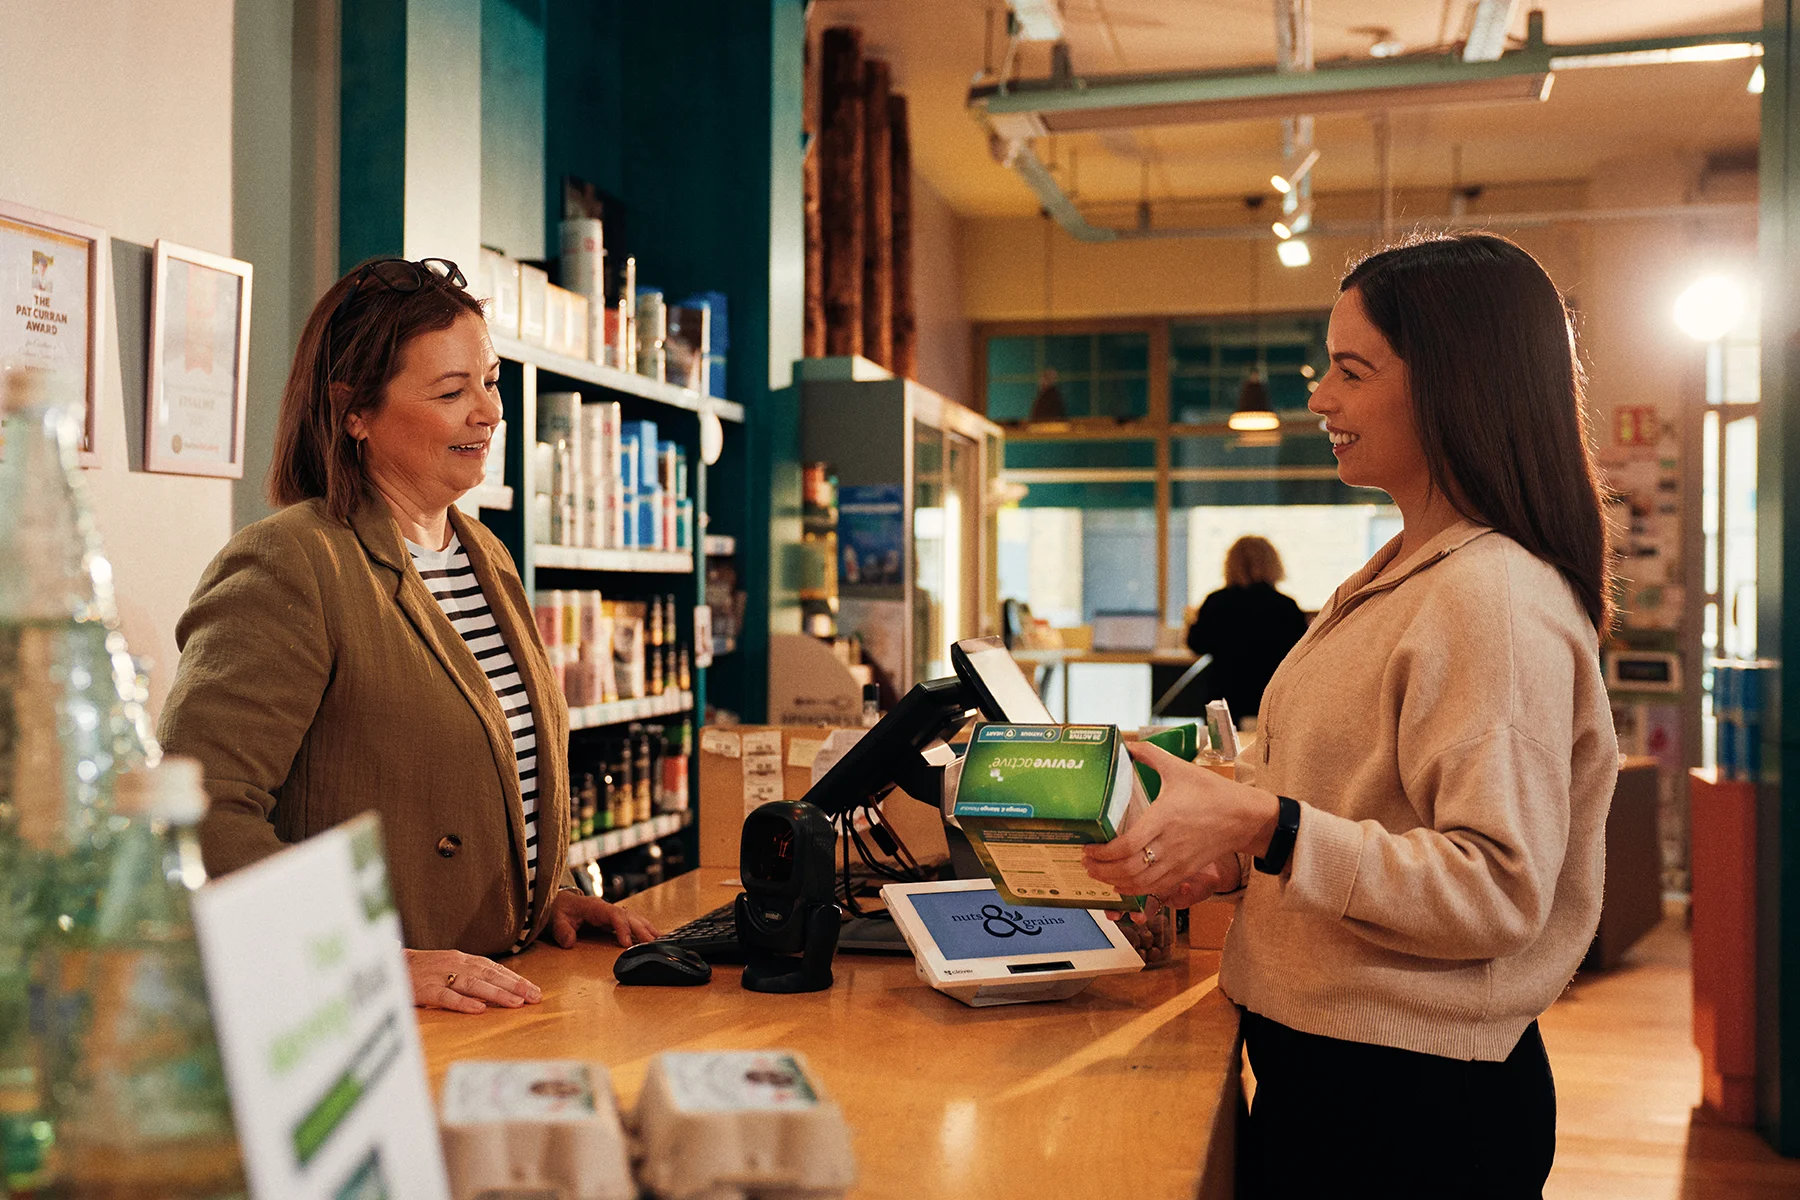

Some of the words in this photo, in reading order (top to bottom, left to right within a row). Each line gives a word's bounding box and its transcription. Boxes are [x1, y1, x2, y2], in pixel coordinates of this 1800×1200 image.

[34, 294, 51, 308] THE
[16, 305, 33, 317] PAT
[33, 308, 68, 324] CURRAN
[25, 320, 58, 336] AWARD
[980, 805, 1000, 813] Mango
[1006, 806, 1028, 814] Orange
[951, 912, 984, 922] nuts
[981, 904, 1042, 938] &
[1023, 915, 1065, 930] grains
